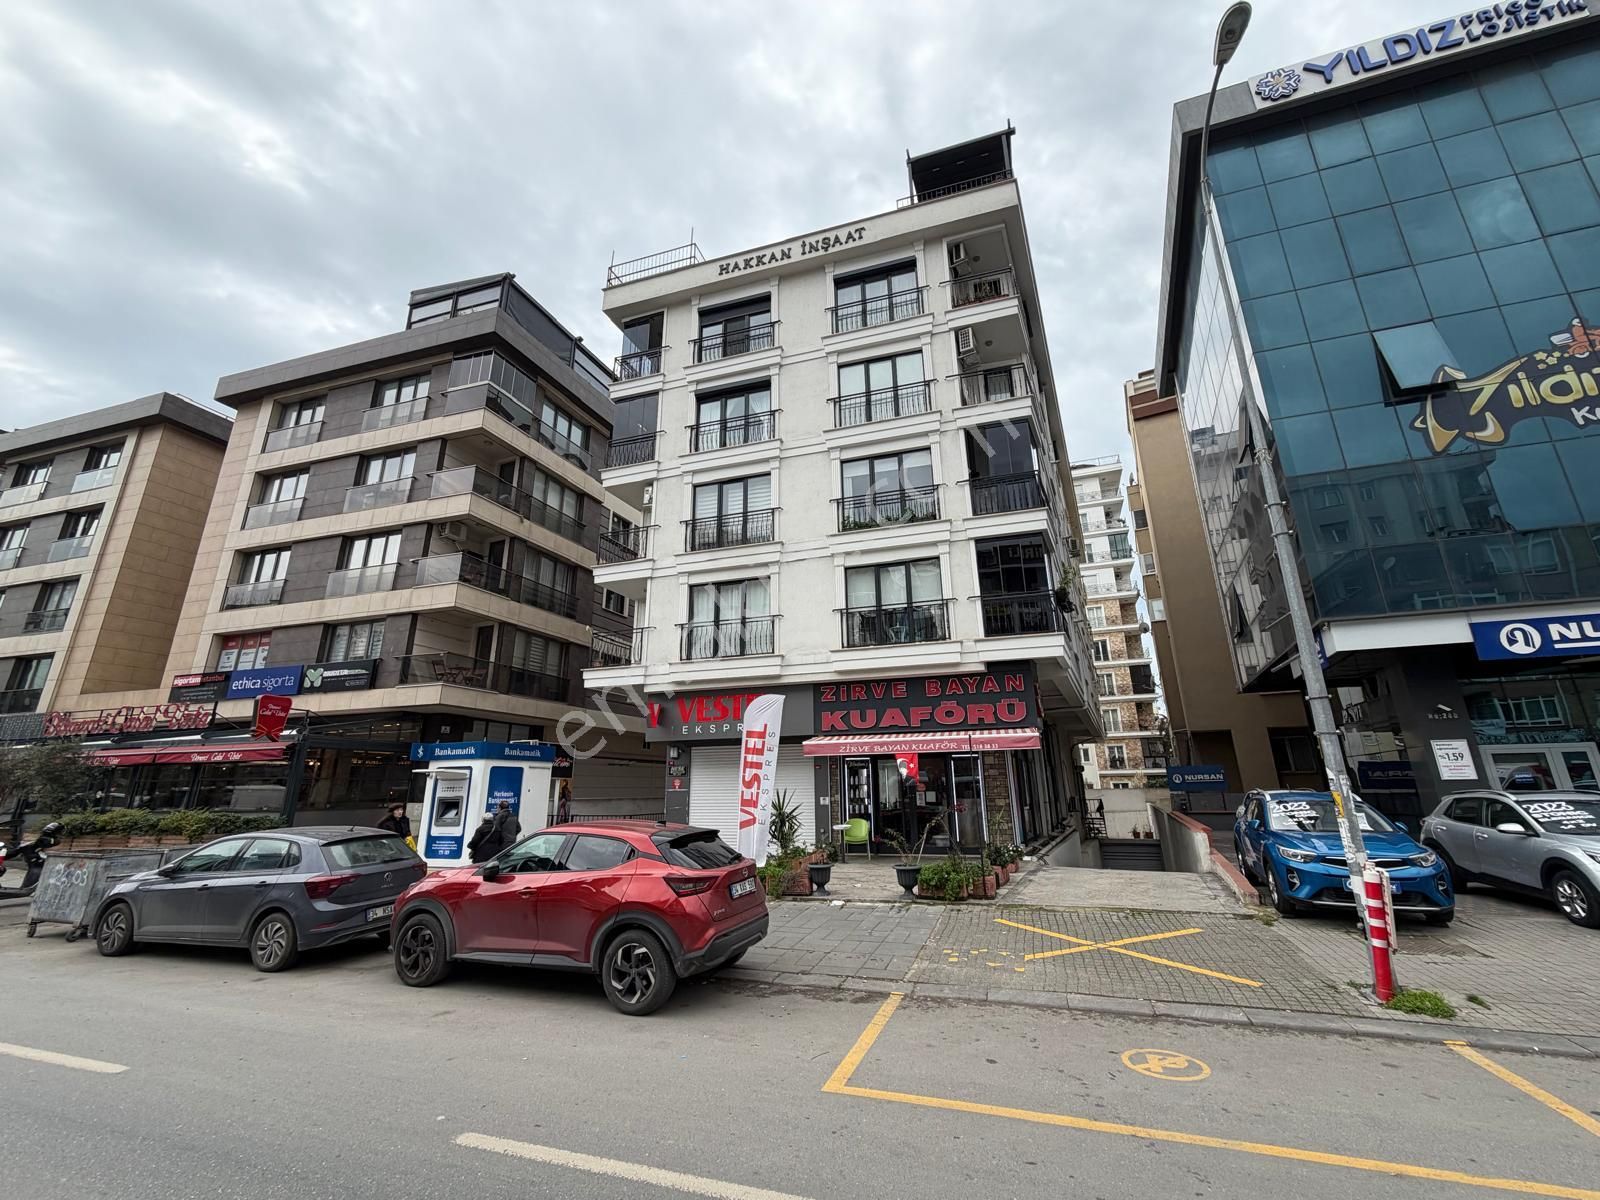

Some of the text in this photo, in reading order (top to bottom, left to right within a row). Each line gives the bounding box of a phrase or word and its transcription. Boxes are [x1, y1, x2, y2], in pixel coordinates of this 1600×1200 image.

[1302, 19, 1465, 84] YILDIZ
[718, 226, 866, 276] HAKKAN İNŞAAT
[232, 675, 295, 692] ethica sigorta
[820, 674, 1025, 702] ZİRVE BAYAN
[820, 698, 1027, 731] KUAFÖRÜ
[434, 746, 476, 756] Bankamatik
[504, 747, 541, 758] Bankamatik
[839, 745, 871, 753] ZİRVE
[873, 744, 909, 752] BAYAN
[911, 740, 958, 750] KUAFÖR
[739, 724, 769, 830] VESTEL
[757, 731, 776, 826] EKSPRES
[1270, 801, 1311, 813] 2023
[1522, 801, 1575, 813] 2023
